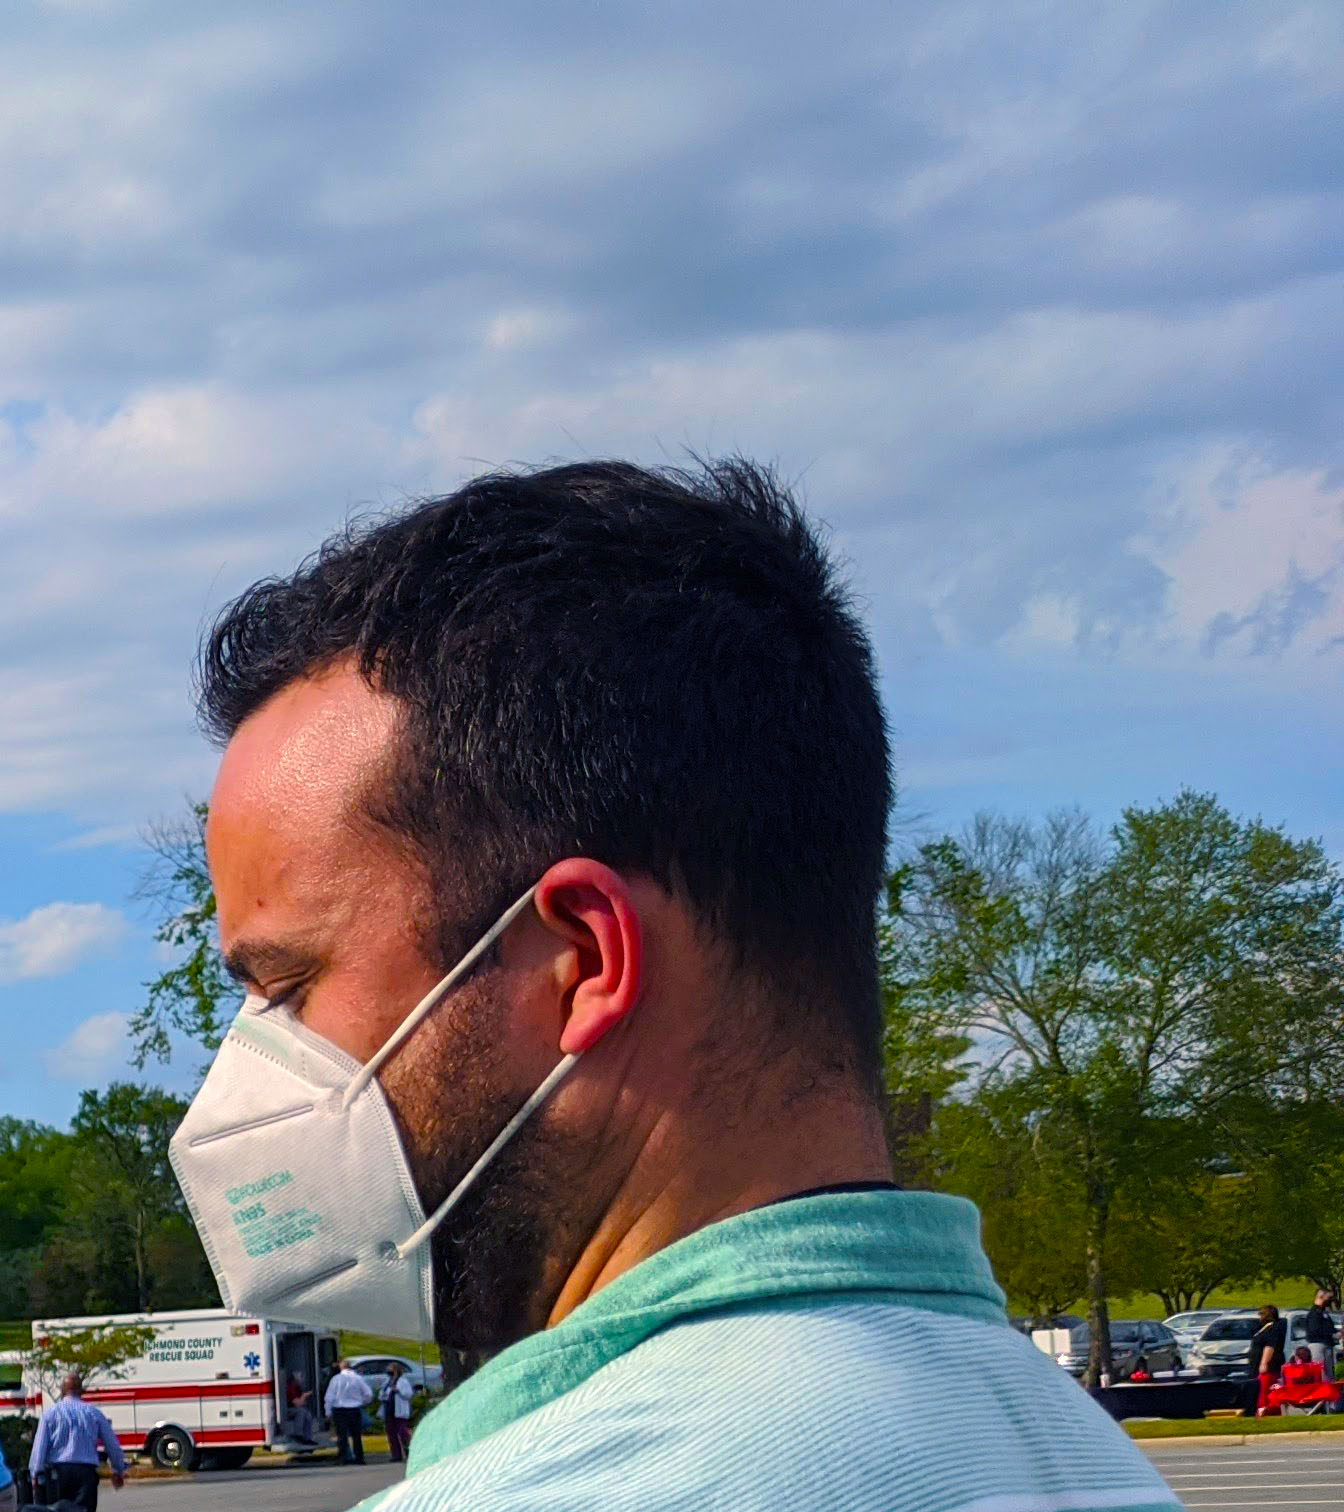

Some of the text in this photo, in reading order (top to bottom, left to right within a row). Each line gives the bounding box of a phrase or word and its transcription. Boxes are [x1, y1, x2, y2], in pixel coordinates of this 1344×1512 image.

[232, 1202, 266, 1225] KN95
[143, 1337, 223, 1351] ICHMOND COUNTY
[149, 1349, 214, 1362] RESCUE SQUAD
